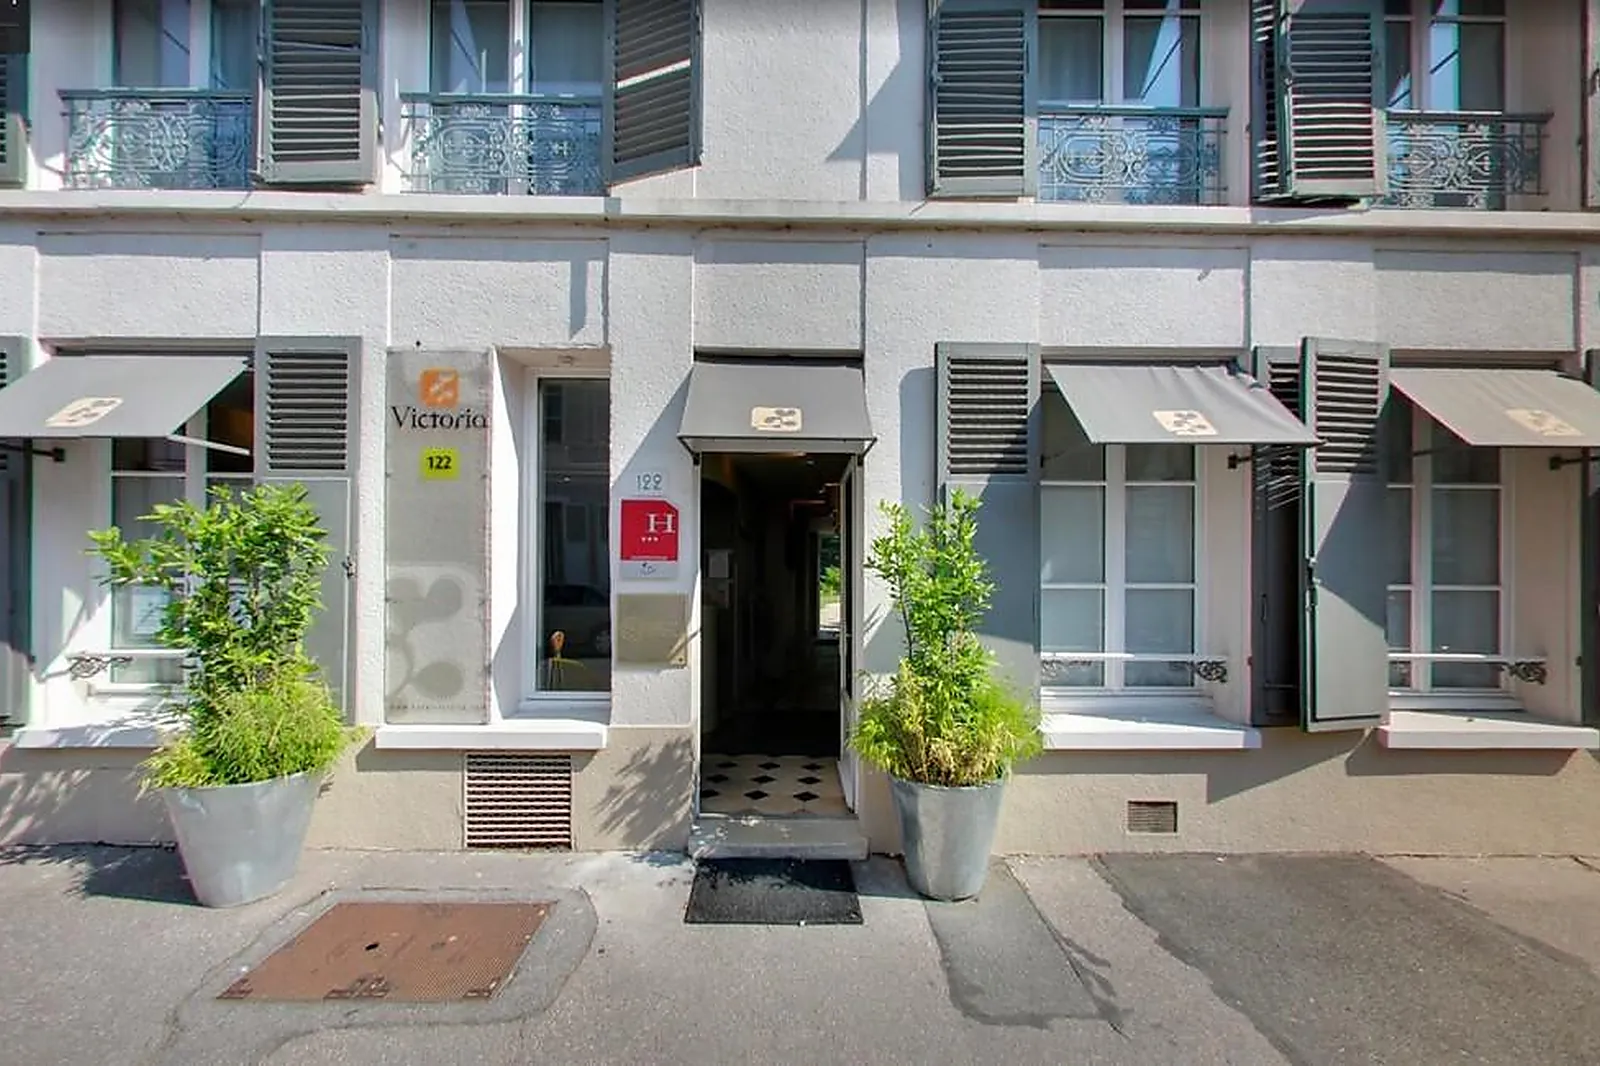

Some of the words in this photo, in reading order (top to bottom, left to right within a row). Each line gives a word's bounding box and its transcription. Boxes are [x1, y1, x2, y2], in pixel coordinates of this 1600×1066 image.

[391, 406, 488, 429] Victoria
[426, 455, 452, 470] 122
[636, 473, 662, 490] 122
[646, 513, 676, 533] H
